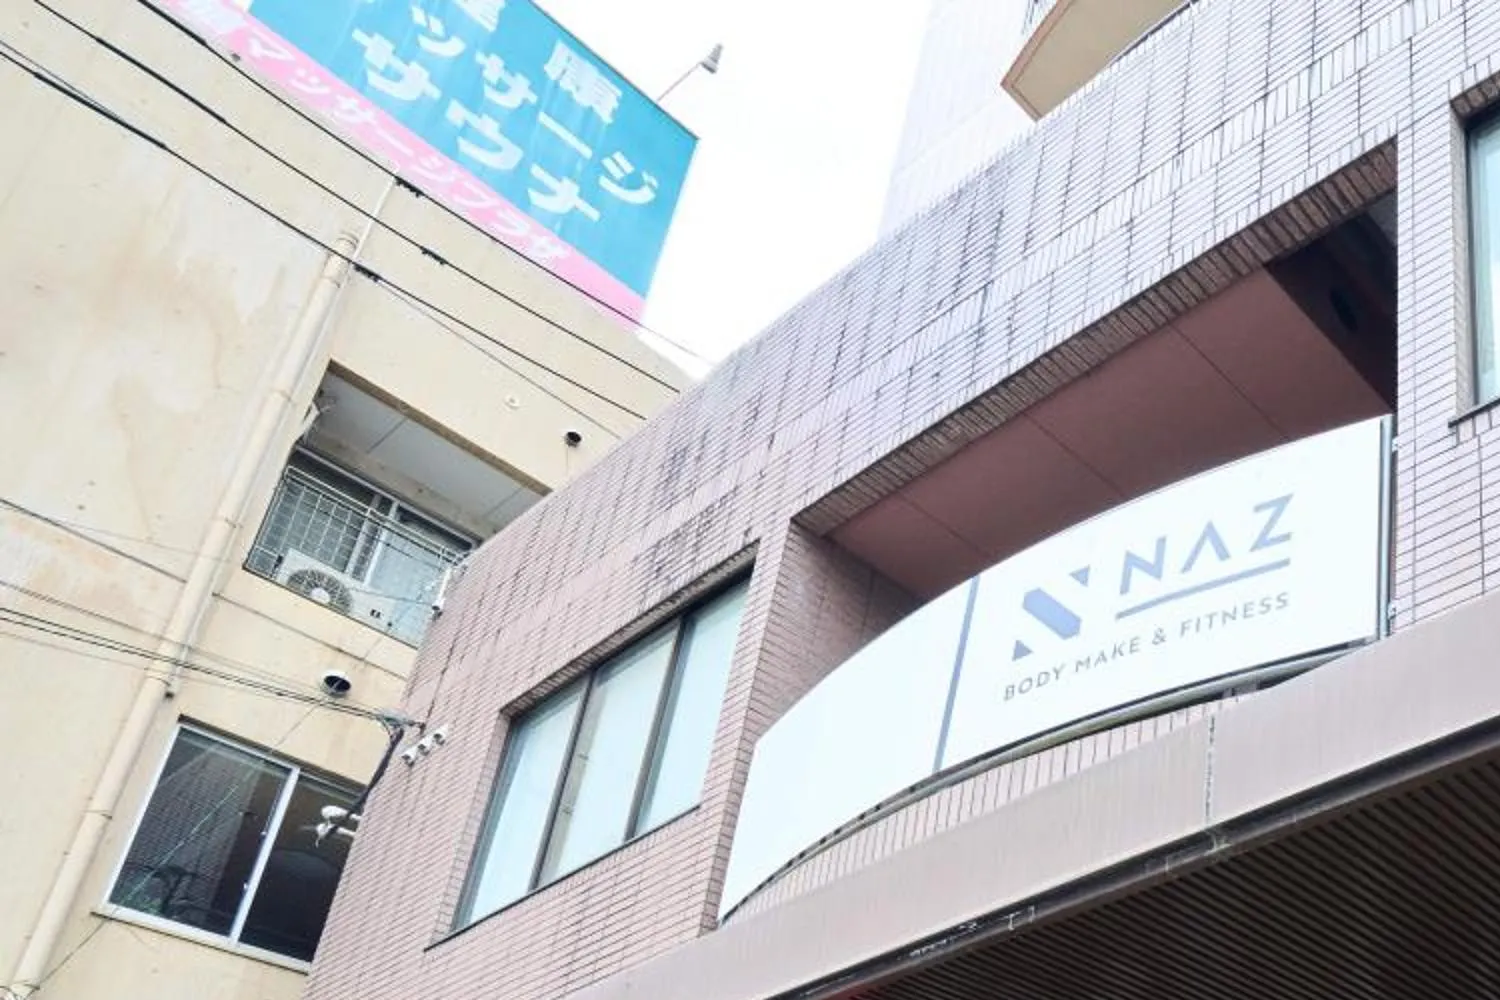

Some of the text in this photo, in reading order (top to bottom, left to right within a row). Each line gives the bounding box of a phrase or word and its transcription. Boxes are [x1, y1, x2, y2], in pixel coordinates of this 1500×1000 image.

[352, 29, 600, 222] サウナ
[375, 0, 658, 204] ッサージ
[1119, 493, 1293, 595] NAZ
[1004, 592, 1290, 702] BODY MAKE & FITNESS
